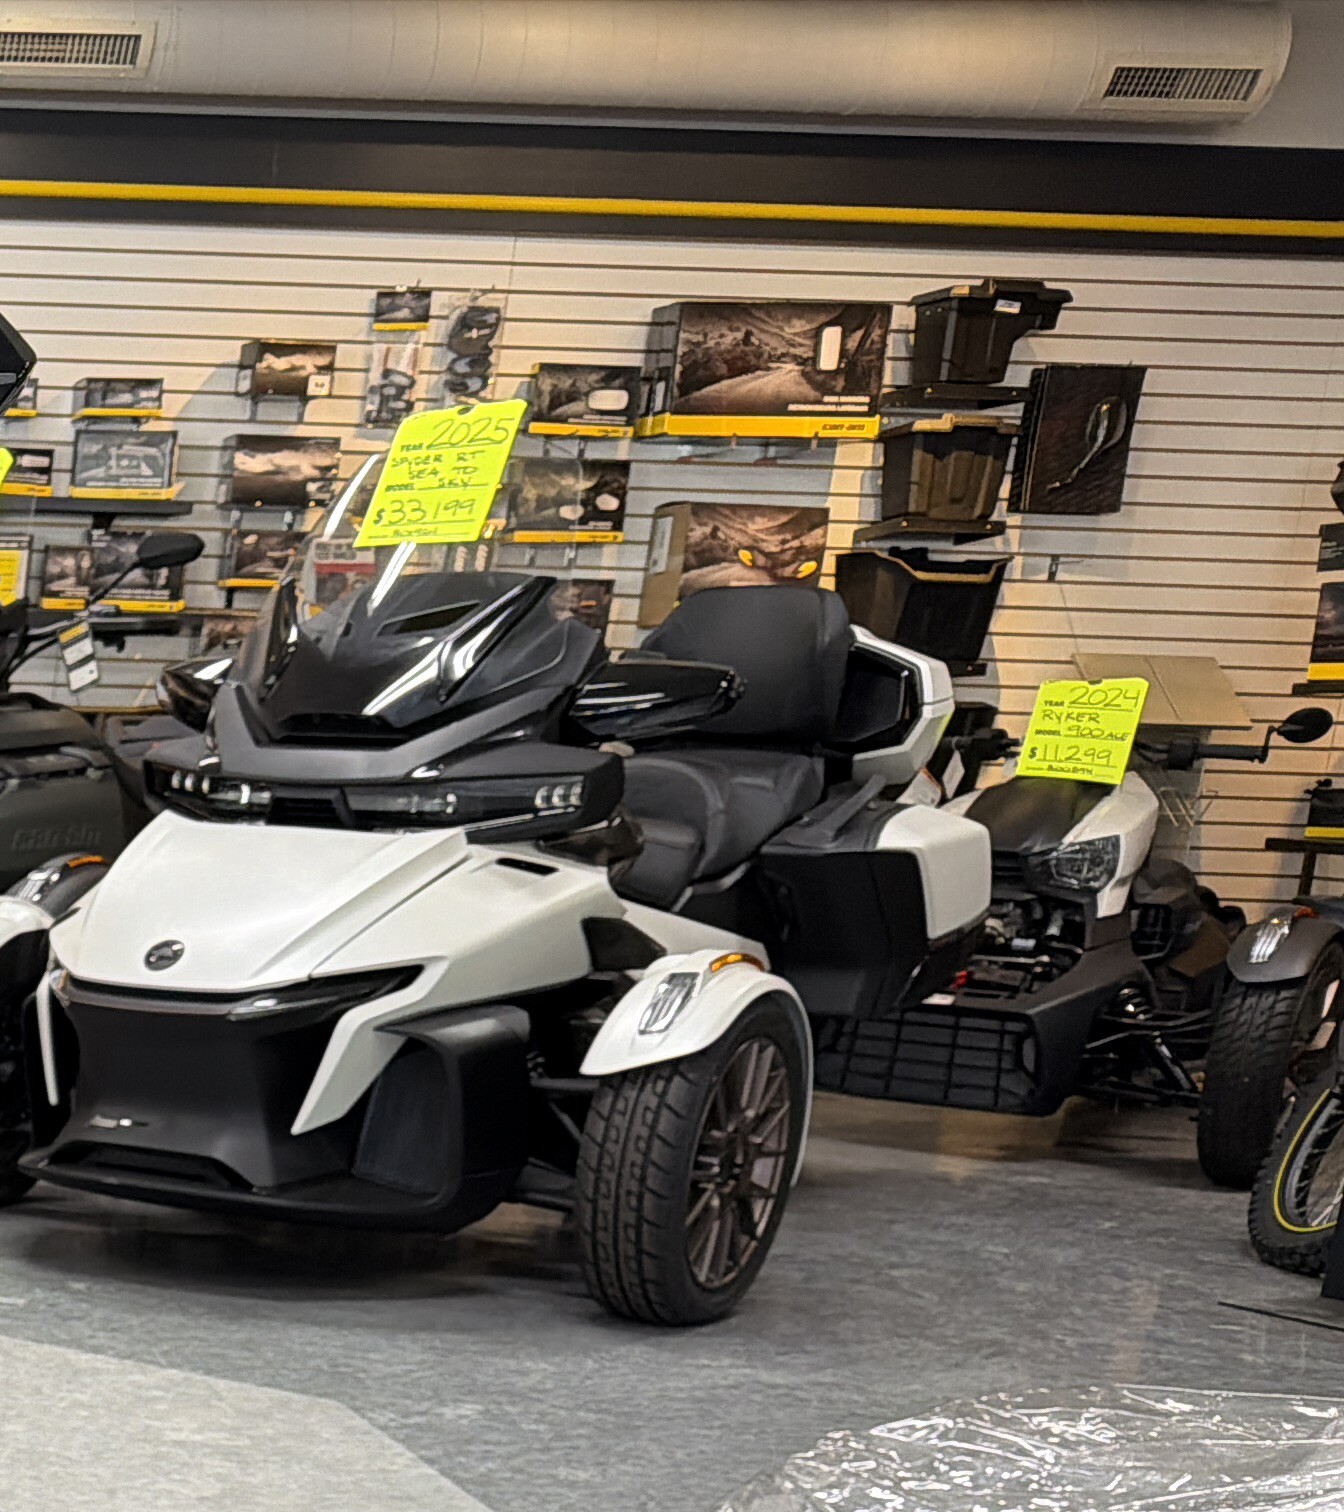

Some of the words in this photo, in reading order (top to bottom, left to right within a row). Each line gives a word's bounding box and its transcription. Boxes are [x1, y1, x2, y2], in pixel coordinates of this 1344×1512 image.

[426, 417, 515, 449] 2025
[1067, 685, 1141, 709] 2024
[1042, 708, 1101, 725] RYKER
[1066, 724, 1105, 737] 900
